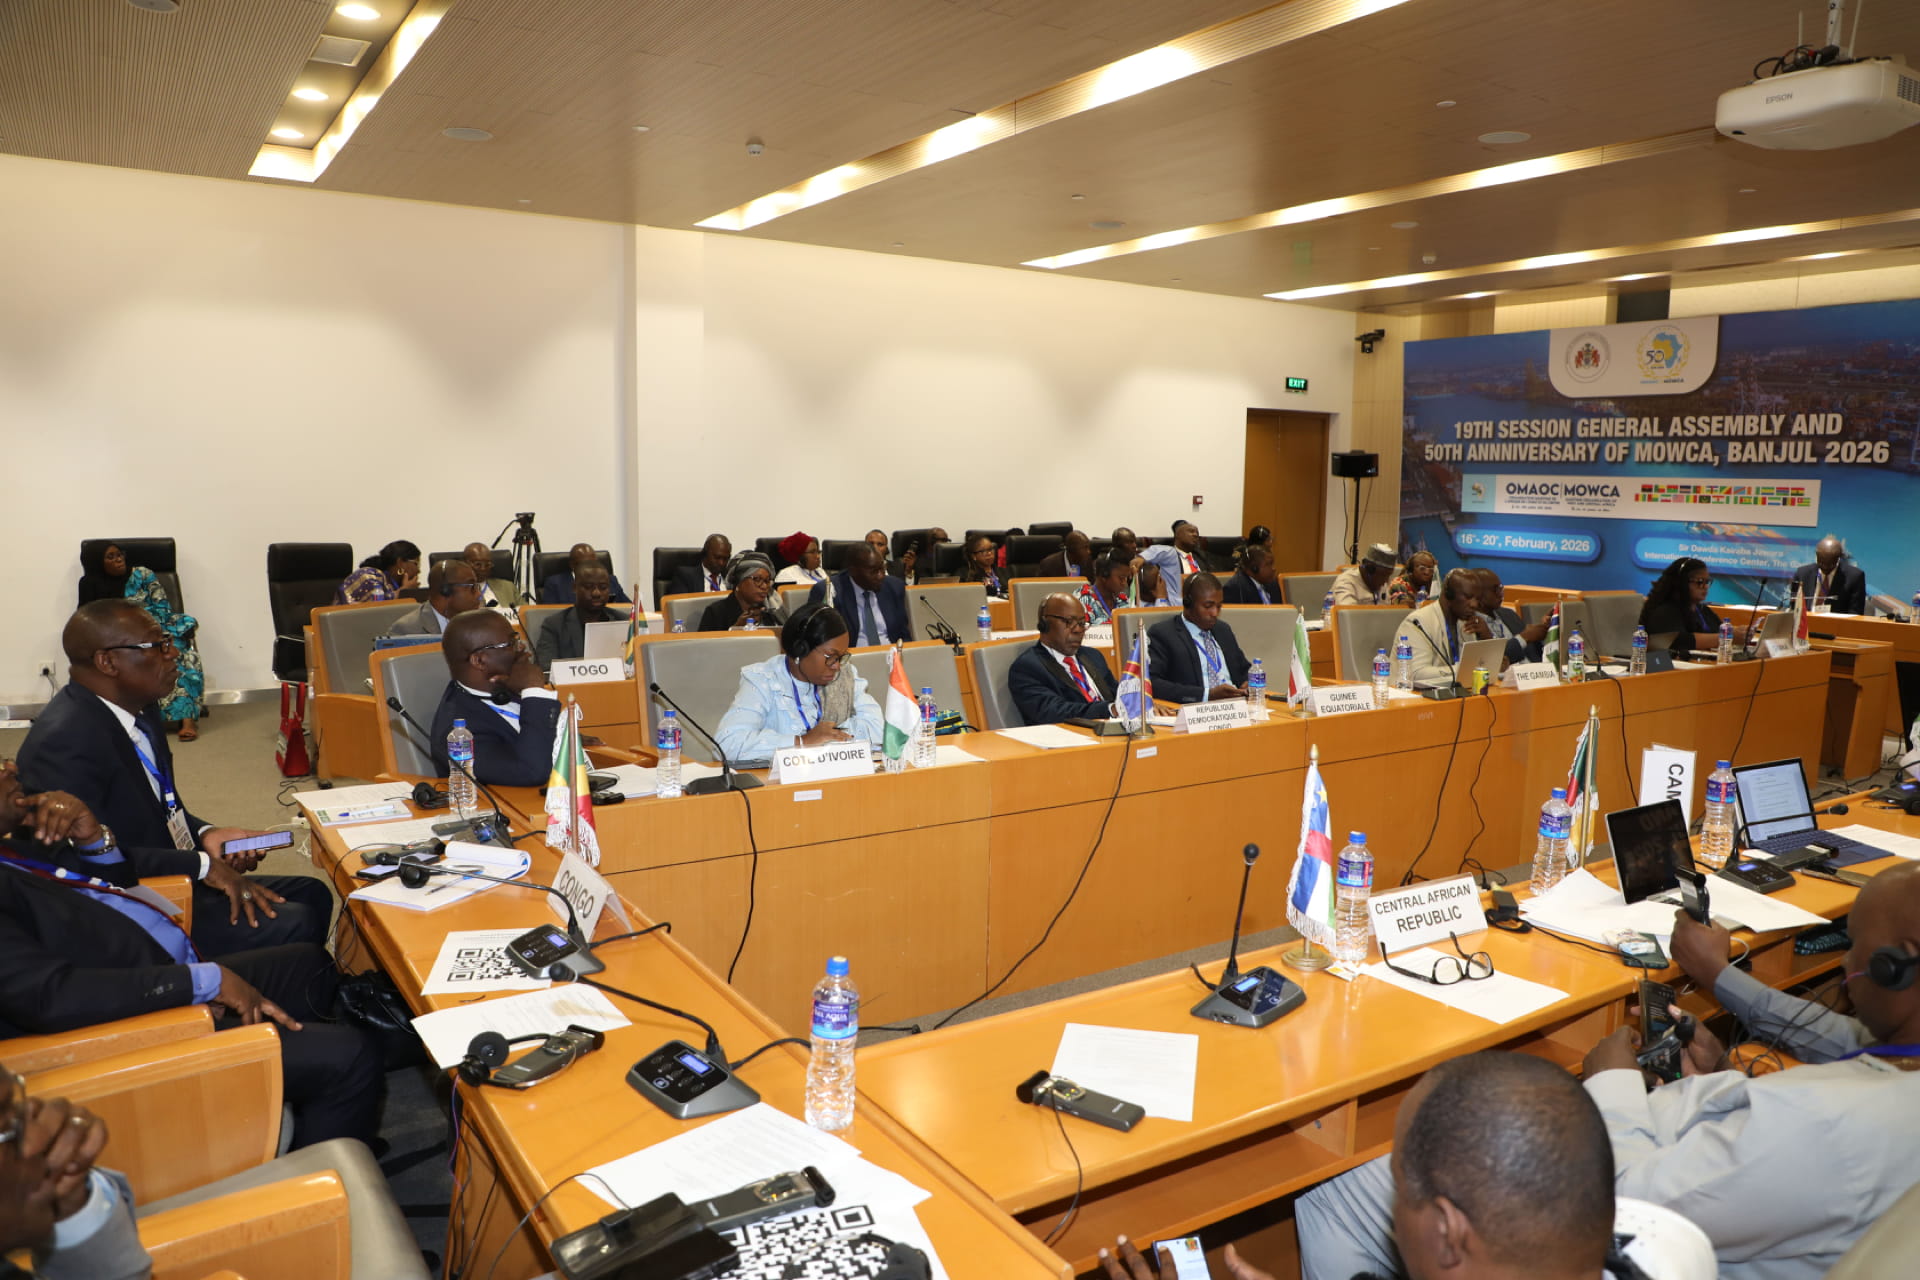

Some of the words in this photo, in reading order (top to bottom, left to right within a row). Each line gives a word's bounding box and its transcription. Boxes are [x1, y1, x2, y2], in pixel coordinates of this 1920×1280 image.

[1765, 92, 1793, 104] EPSON
[1289, 378, 1305, 388] EXIT
[1454, 421, 1493, 439] 19TH
[1498, 418, 1571, 439] SESSION
[1577, 416, 1664, 438] GENERAL
[1668, 414, 1786, 437] ASSEMBLY
[1791, 413, 1843, 435] AND
[1424, 443, 1463, 461] 50TH
[1604, 442, 1630, 462] OF
[1634, 441, 1720, 466] MOWCA,
[1727, 441, 1817, 463] BANJUL
[1824, 440, 1890, 463] 2026
[1506, 482, 1560, 496] OMAOC
[1564, 484, 1620, 497] MOWCA
[1504, 535, 1558, 552] February,
[1561, 540, 1590, 552] 2026
[569, 664, 608, 676] TOGO
[1517, 672, 1528, 681] THE
[1530, 670, 1555, 680] GAMBIA
[1239, 711, 1248, 720] DU
[1320, 702, 1370, 713] EQUATORIALE
[1666, 763, 1684, 800] CAM
[559, 869, 595, 919] CONGO
[1375, 894, 1426, 915] CENTRAL
[1428, 883, 1471, 904] AFRICAN
[1396, 905, 1462, 933] REPUBLIC
